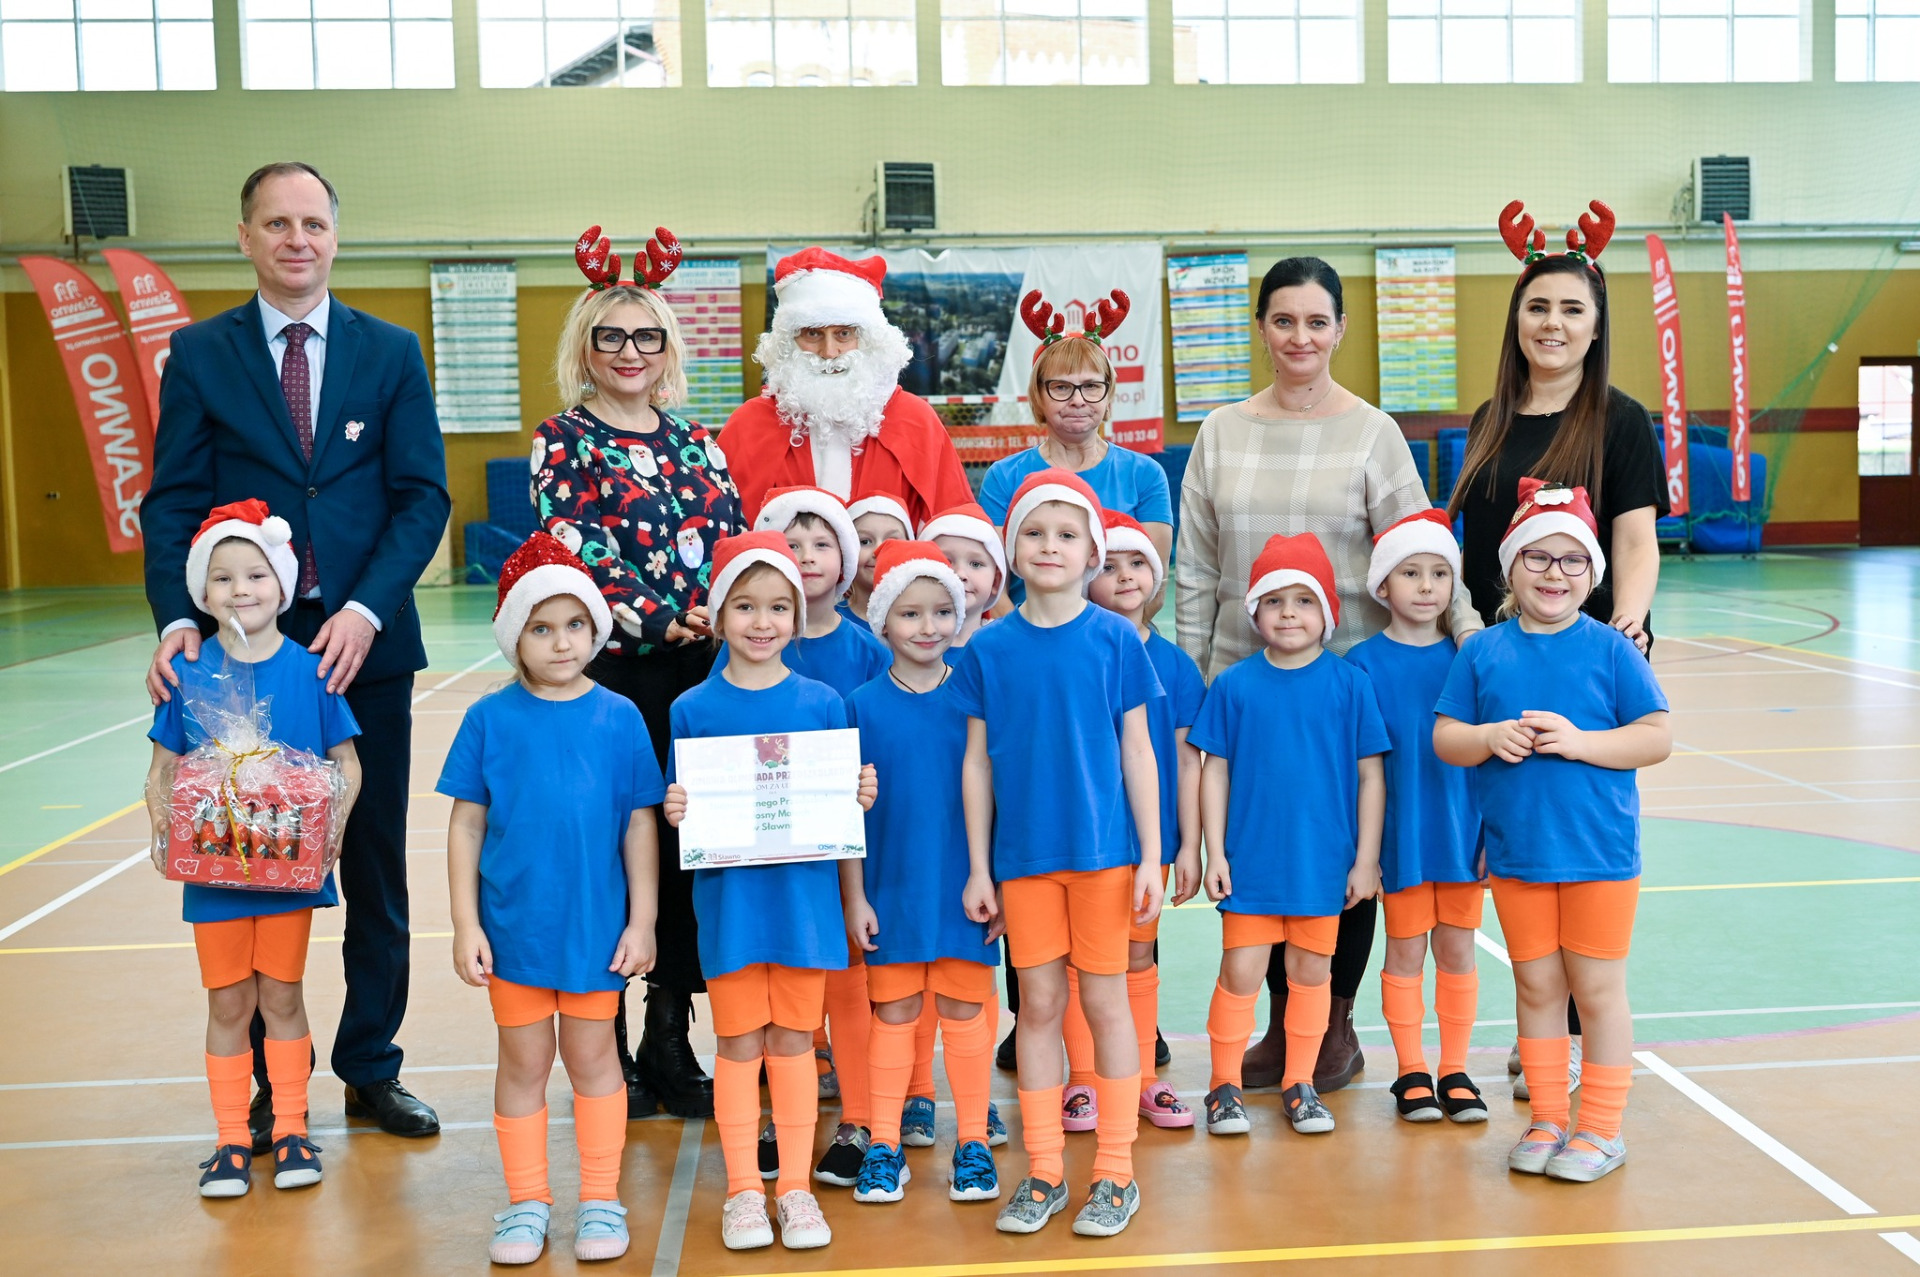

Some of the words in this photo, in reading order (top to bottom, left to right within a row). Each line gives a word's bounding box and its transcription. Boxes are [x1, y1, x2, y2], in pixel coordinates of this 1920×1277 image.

[1108, 345, 1138, 361] no
[1114, 388, 1146, 405] no.pl
[755, 800, 778, 809] nego
[755, 812, 777, 821] osny
